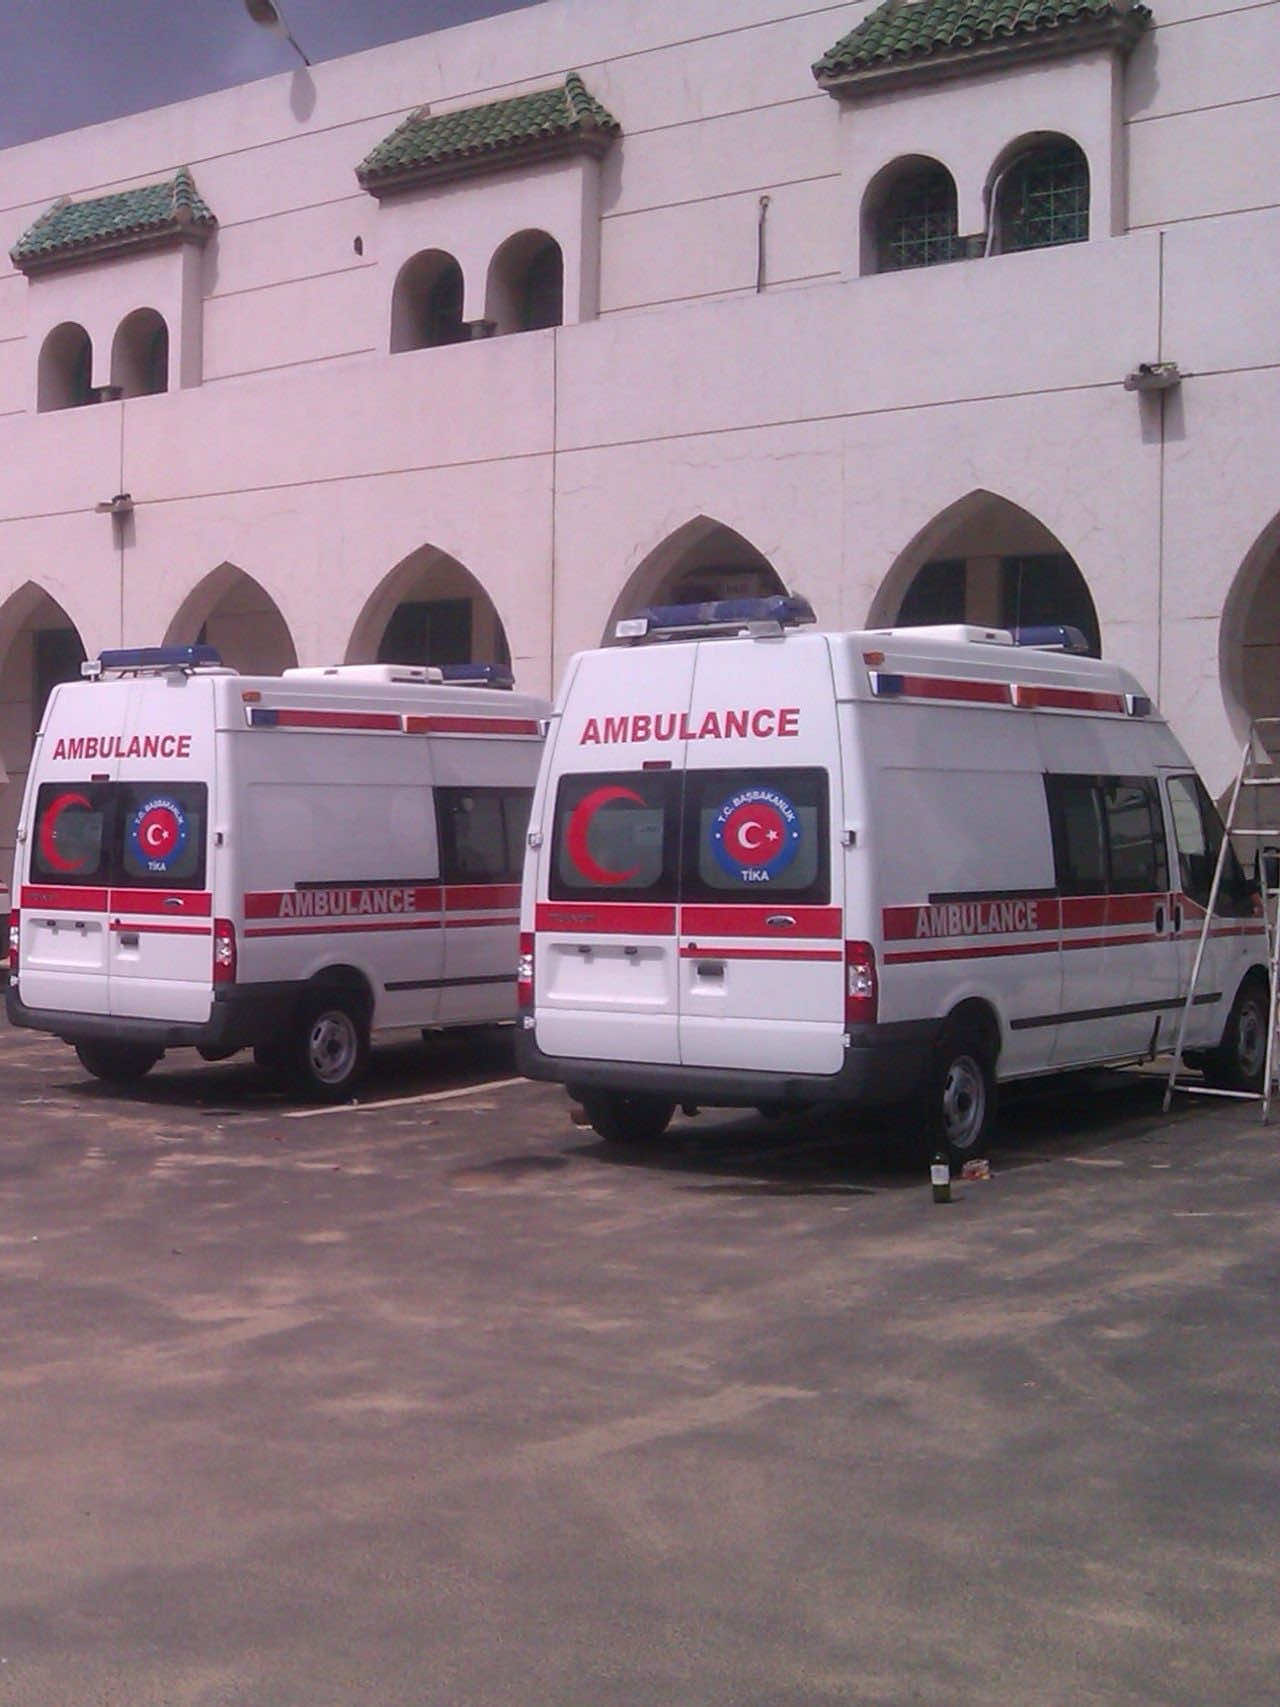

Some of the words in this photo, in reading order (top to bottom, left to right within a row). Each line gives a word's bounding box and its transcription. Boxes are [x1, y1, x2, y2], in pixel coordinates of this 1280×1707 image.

[579, 708, 801, 745] AMBULANCE
[53, 735, 192, 760] AMBULANCE
[279, 886, 416, 917] AMBULANCE
[916, 901, 1038, 938] AMBULANCE
